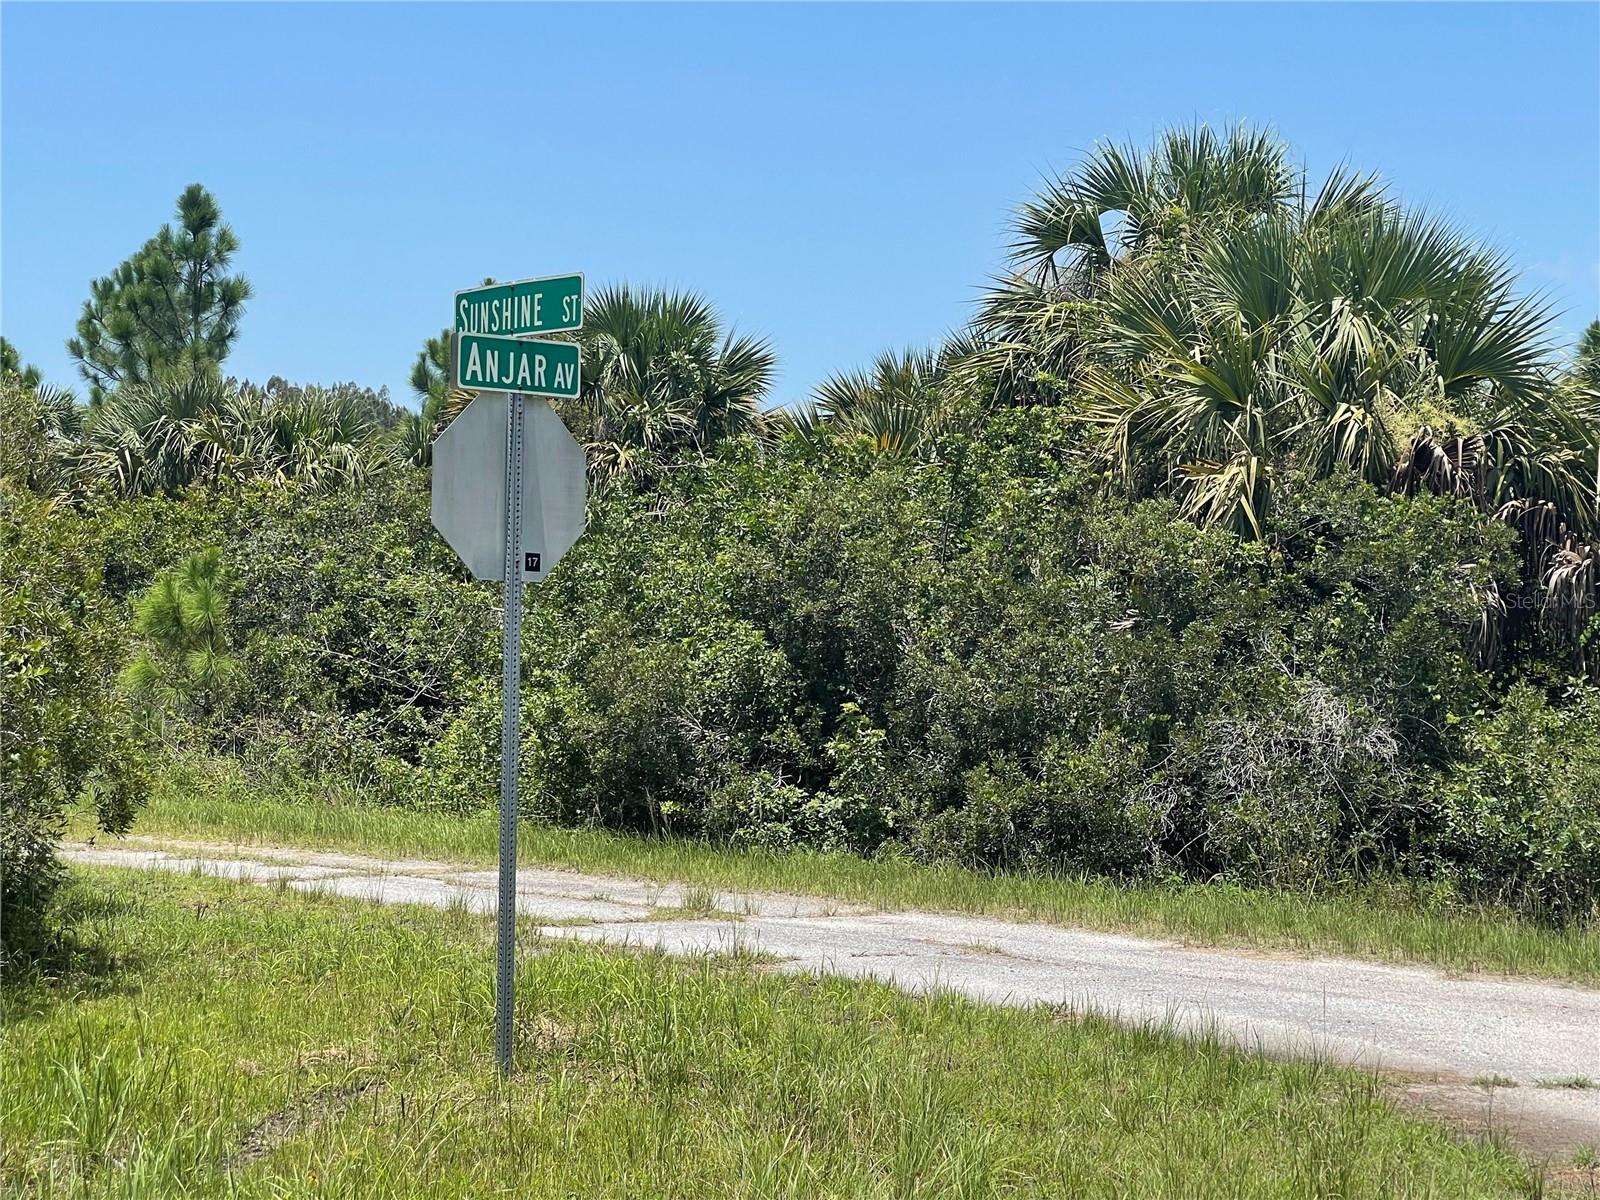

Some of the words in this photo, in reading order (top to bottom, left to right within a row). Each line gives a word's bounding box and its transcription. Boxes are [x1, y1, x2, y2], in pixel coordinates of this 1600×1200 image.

[459, 293, 543, 334] SUNSHINE
[562, 294, 579, 323] ST
[465, 342, 547, 388] ANJAR
[554, 362, 575, 390] AV
[527, 556, 539, 567] 17
